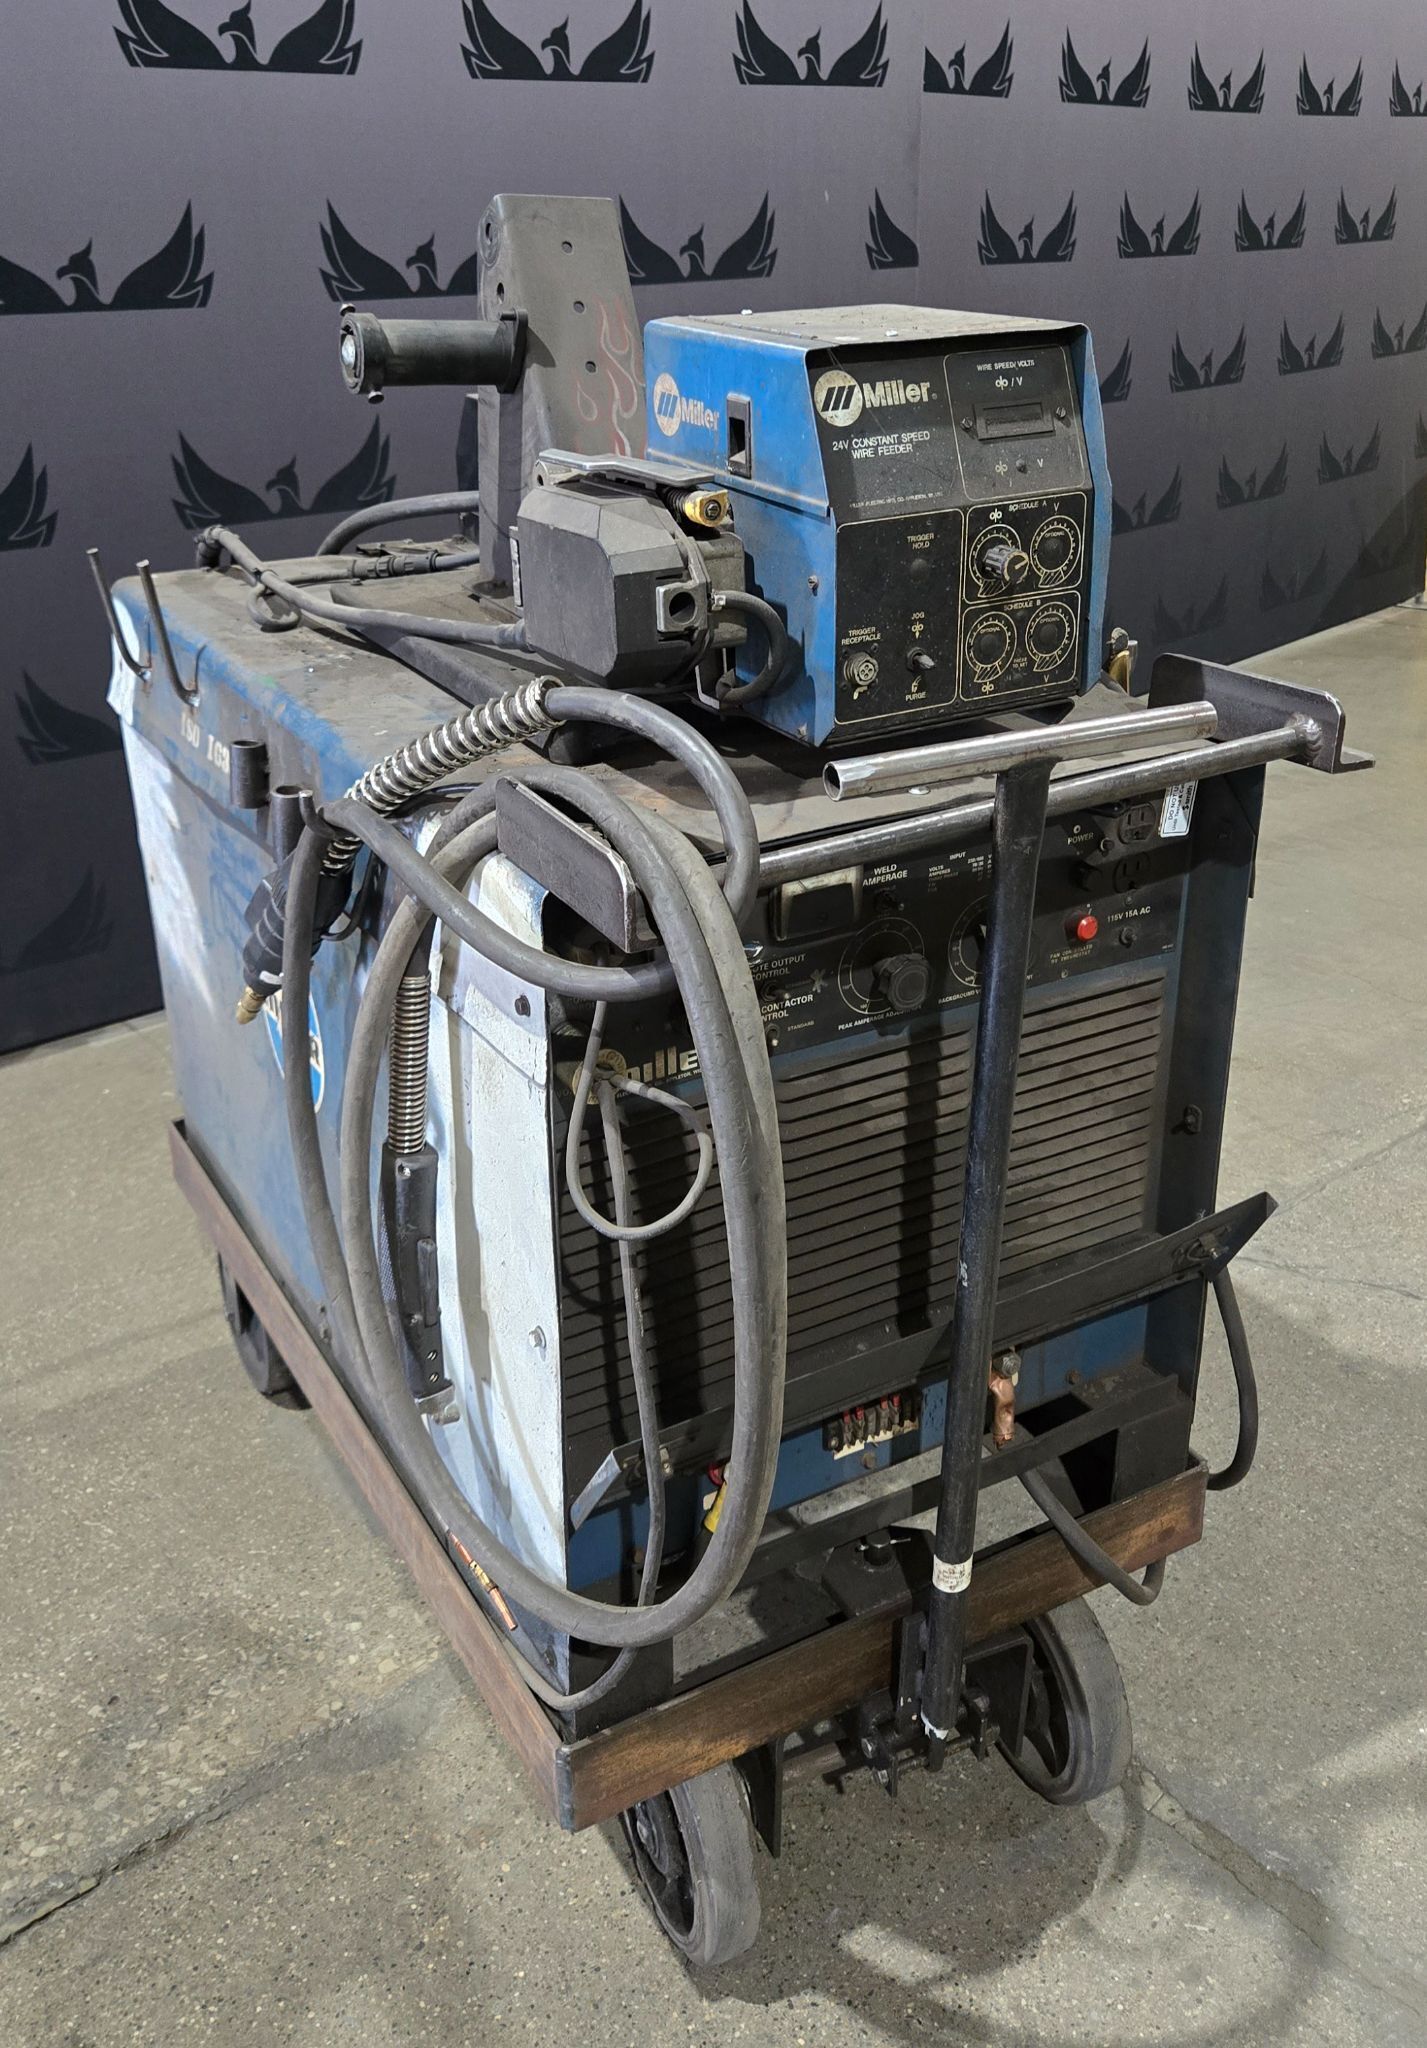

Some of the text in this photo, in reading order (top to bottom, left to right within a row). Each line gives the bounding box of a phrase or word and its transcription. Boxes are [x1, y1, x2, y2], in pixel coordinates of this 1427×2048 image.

[977, 363, 992, 371] WIRE
[862, 379, 930, 408] Miller
[681, 397, 720, 430] Miller
[832, 430, 930, 451] 24V CONSTANT SPEED
[851, 443, 913, 459] WIRE FEEDER
[1037, 458, 1044, 468] V
[1008, 499, 1047, 512] SCHEDULE A
[1054, 502, 1060, 512] V
[907, 533, 934, 543] TRIGGER
[912, 541, 930, 550] HOLD
[1004, 600, 1034, 611] SCHEDULE
[911, 611, 925, 620] JOG
[848, 626, 876, 637] TRIGGER
[841, 633, 881, 646] RECEPTACLE
[905, 691, 927, 701] PURGE
[1167, 810, 1175, 820] DO
[1067, 832, 1094, 846] POWER
[949, 851, 967, 861] INPUT
[873, 863, 897, 875] WELD
[928, 864, 944, 872] VOLTS
[862, 869, 908, 887] AMPERAGE
[1107, 905, 1151, 924] 115V 15A AC
[771, 953, 806, 969] OUTPUT
[937, 989, 975, 1005] BACKGROUND
[761, 994, 814, 1014] CONTACTOR
[761, 1009, 789, 1022] NTROL
[838, 1020, 853, 1031] PEAK
[853, 1014, 885, 1027] AMPERAGE
